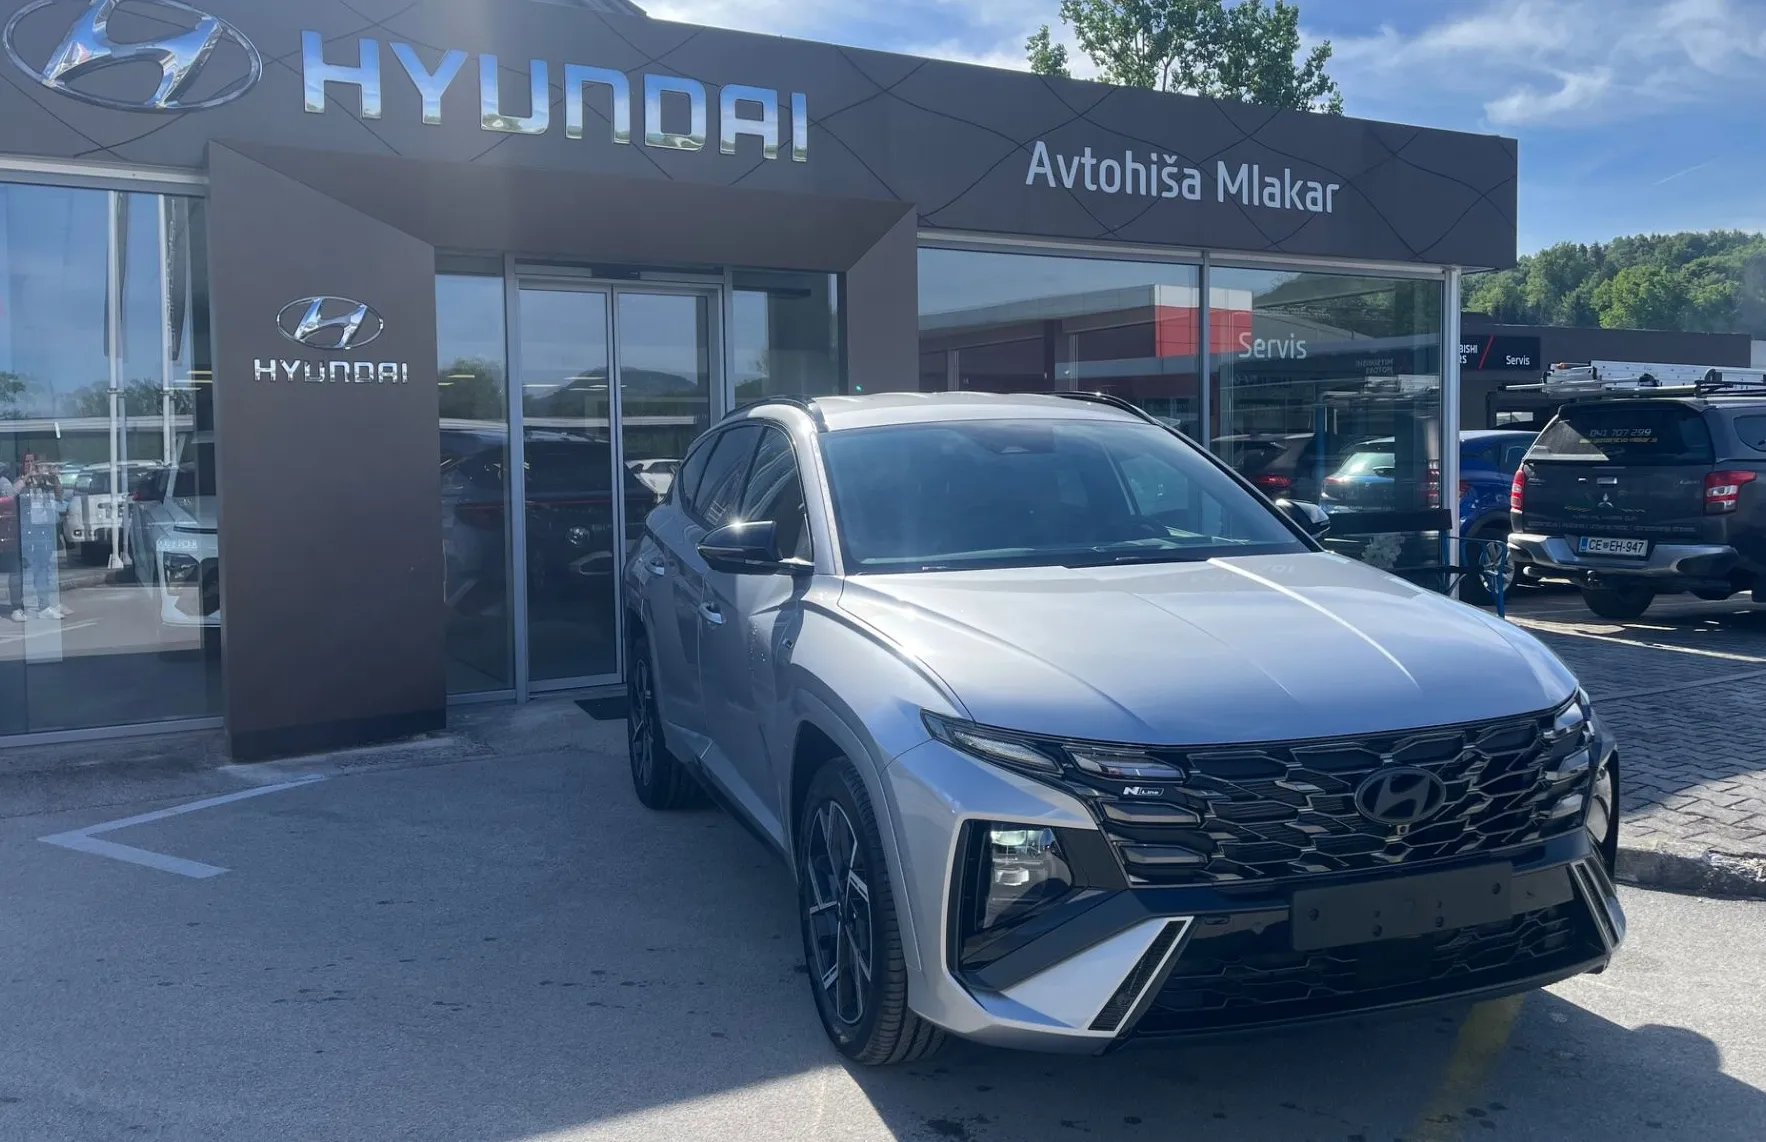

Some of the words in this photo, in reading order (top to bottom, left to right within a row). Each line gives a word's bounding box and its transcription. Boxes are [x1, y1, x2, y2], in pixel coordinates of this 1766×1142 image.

[302, 30, 808, 162] HYUNDAI
[1025, 140, 1201, 201] Avtohiša
[1216, 160, 1340, 213] Mlakar
[1238, 332, 1307, 359] Servis
[253, 358, 409, 384] HYUNDAI
[1505, 355, 1531, 366] Servis
[1589, 539, 1603, 551] CE
[1609, 540, 1645, 553] EH-947
